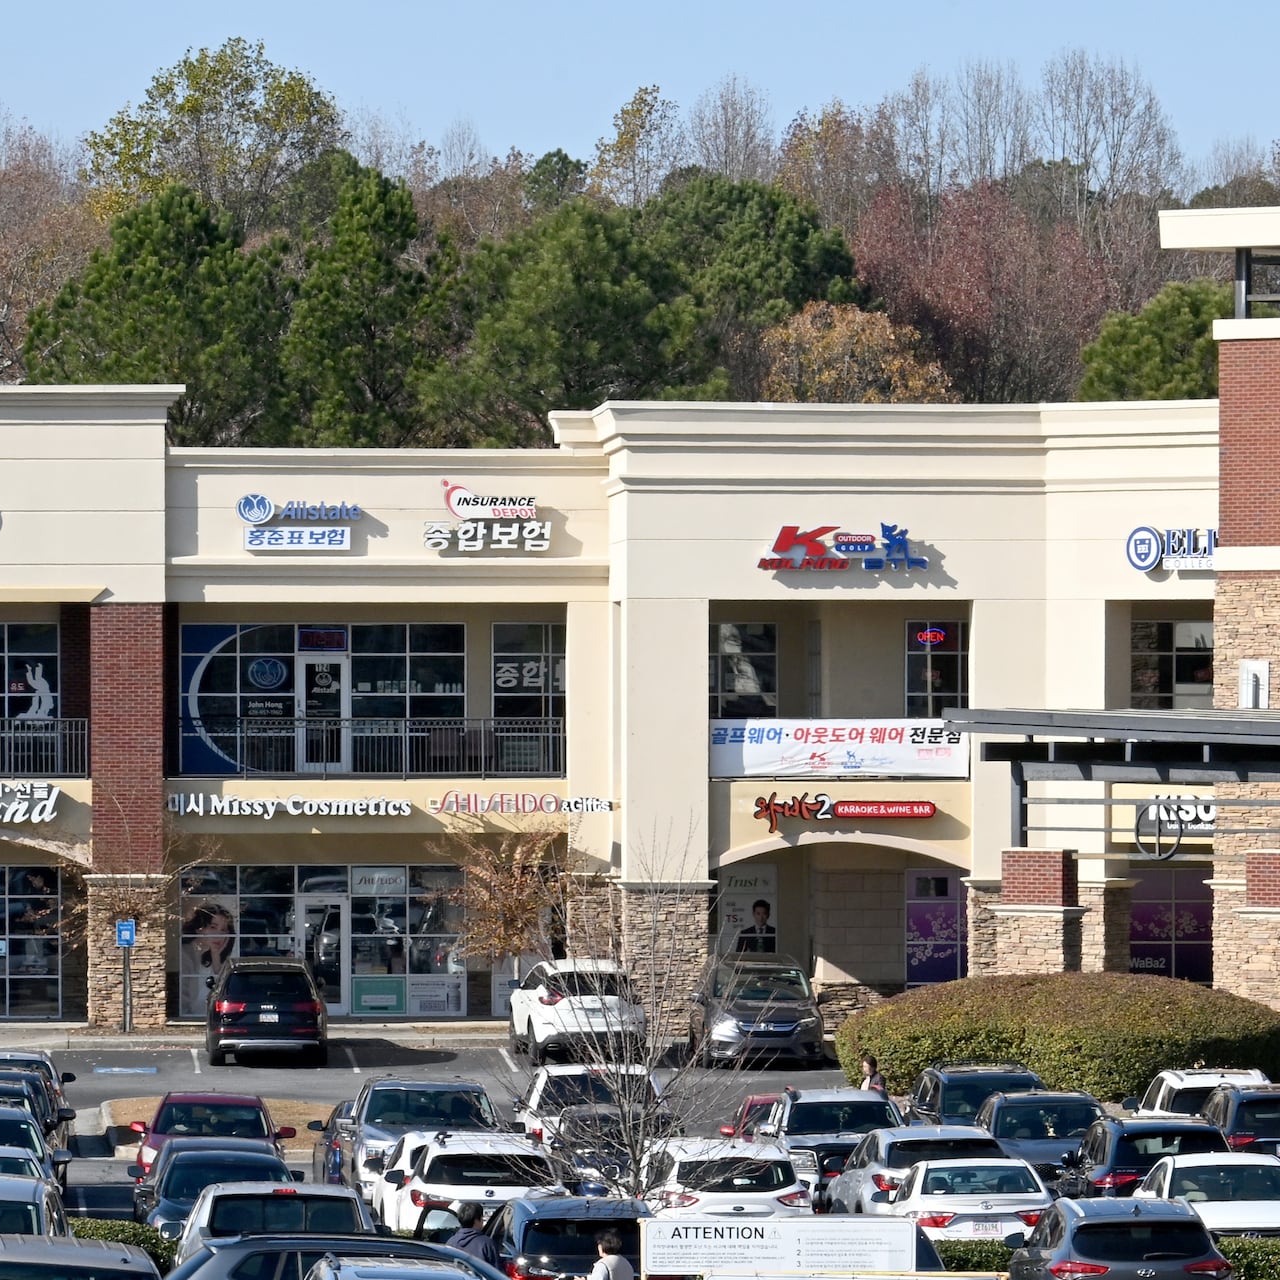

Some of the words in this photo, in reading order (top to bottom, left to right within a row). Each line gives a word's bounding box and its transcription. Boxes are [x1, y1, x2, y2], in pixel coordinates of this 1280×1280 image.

[456, 496, 536, 507] INSURANCE
[279, 500, 362, 521] Allstate
[492, 508, 536, 519] DEPOT
[247, 528, 304, 546] 홍준표
[308, 528, 346, 546] 보험
[423, 520, 552, 552] 종합보험
[917, 630, 945, 642] OPEN
[495, 661, 548, 689] 종합
[248, 701, 264, 709] John
[265, 701, 283, 710] Hong
[793, 727, 864, 744] 아웃도어
[869, 727, 906, 744] 웨어
[210, 794, 278, 820] Missy
[286, 794, 412, 817] Cosmetics
[435, 790, 559, 815] SHISEIDO
[837, 805, 879, 814] KARAOKE
[887, 805, 911, 814] WINE
[913, 805, 931, 814] BAR
[727, 875, 758, 888] Trust
[1130, 957, 1166, 968] WaBa2
[671, 1227, 764, 1239] ATTENTION
